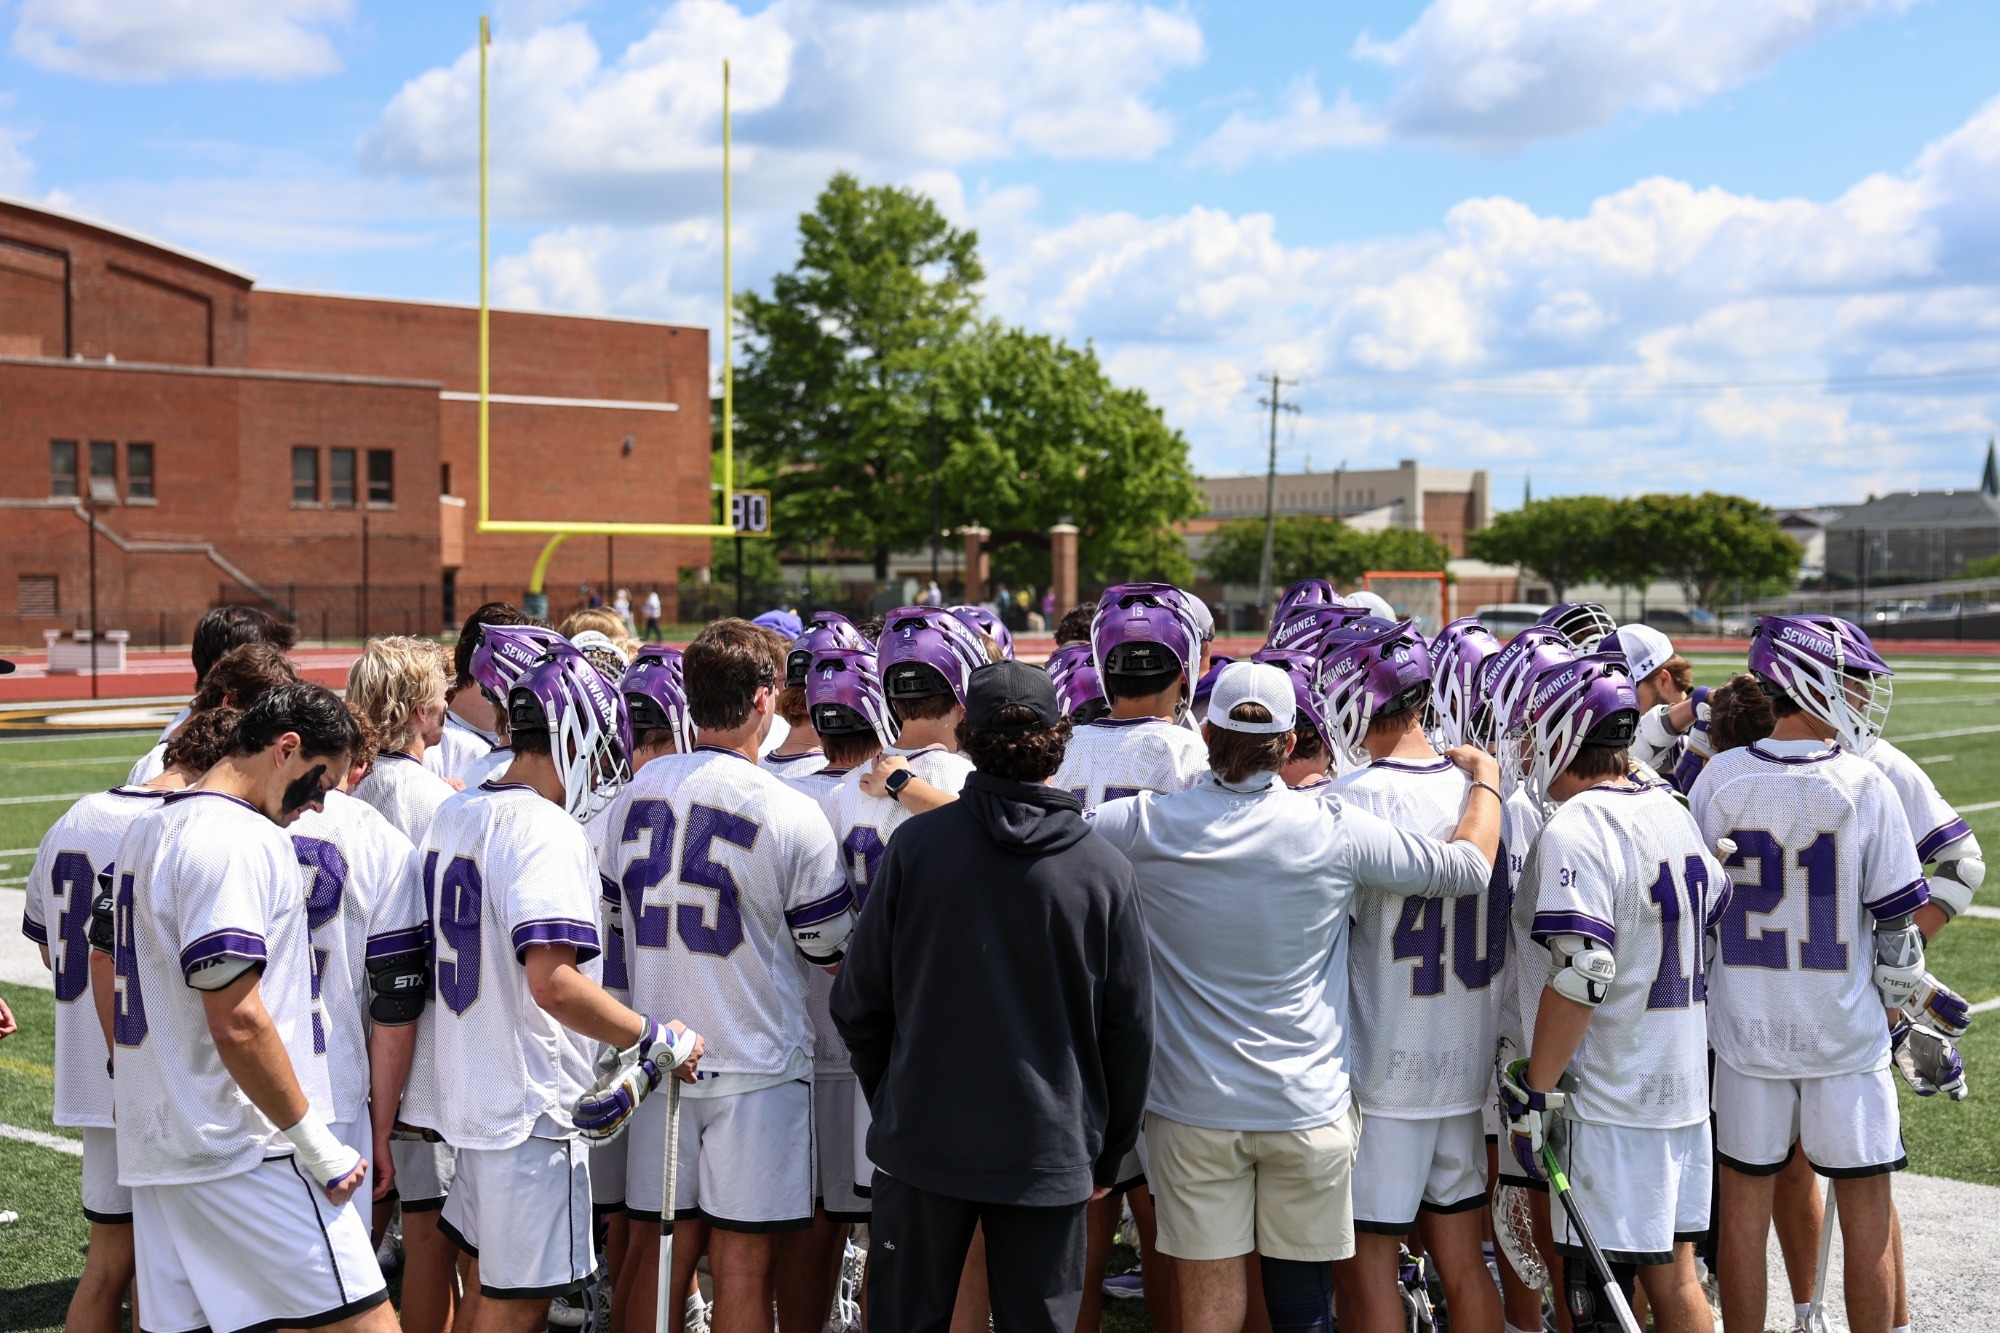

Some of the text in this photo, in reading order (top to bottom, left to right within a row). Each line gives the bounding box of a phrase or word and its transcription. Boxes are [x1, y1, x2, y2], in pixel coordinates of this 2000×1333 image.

[1132, 606, 1144, 617] 15
[903, 628, 911, 638] 3
[1278, 614, 1317, 645] SEWANEE
[501, 642, 536, 668] SEWA
[1394, 651, 1410, 664] 40
[1484, 642, 1521, 692] SEWANEE
[822, 670, 833, 680] 14
[1531, 668, 1577, 715] SEWANEE
[621, 797, 763, 960] 25
[1560, 867, 1577, 889] 31
[98, 898, 114, 911] ST
[1719, 828, 1851, 974] 21
[51, 849, 97, 1004] 3
[422, 847, 483, 1019] 19
[1390, 846, 1510, 999] 40
[394, 972, 425, 989] STX
